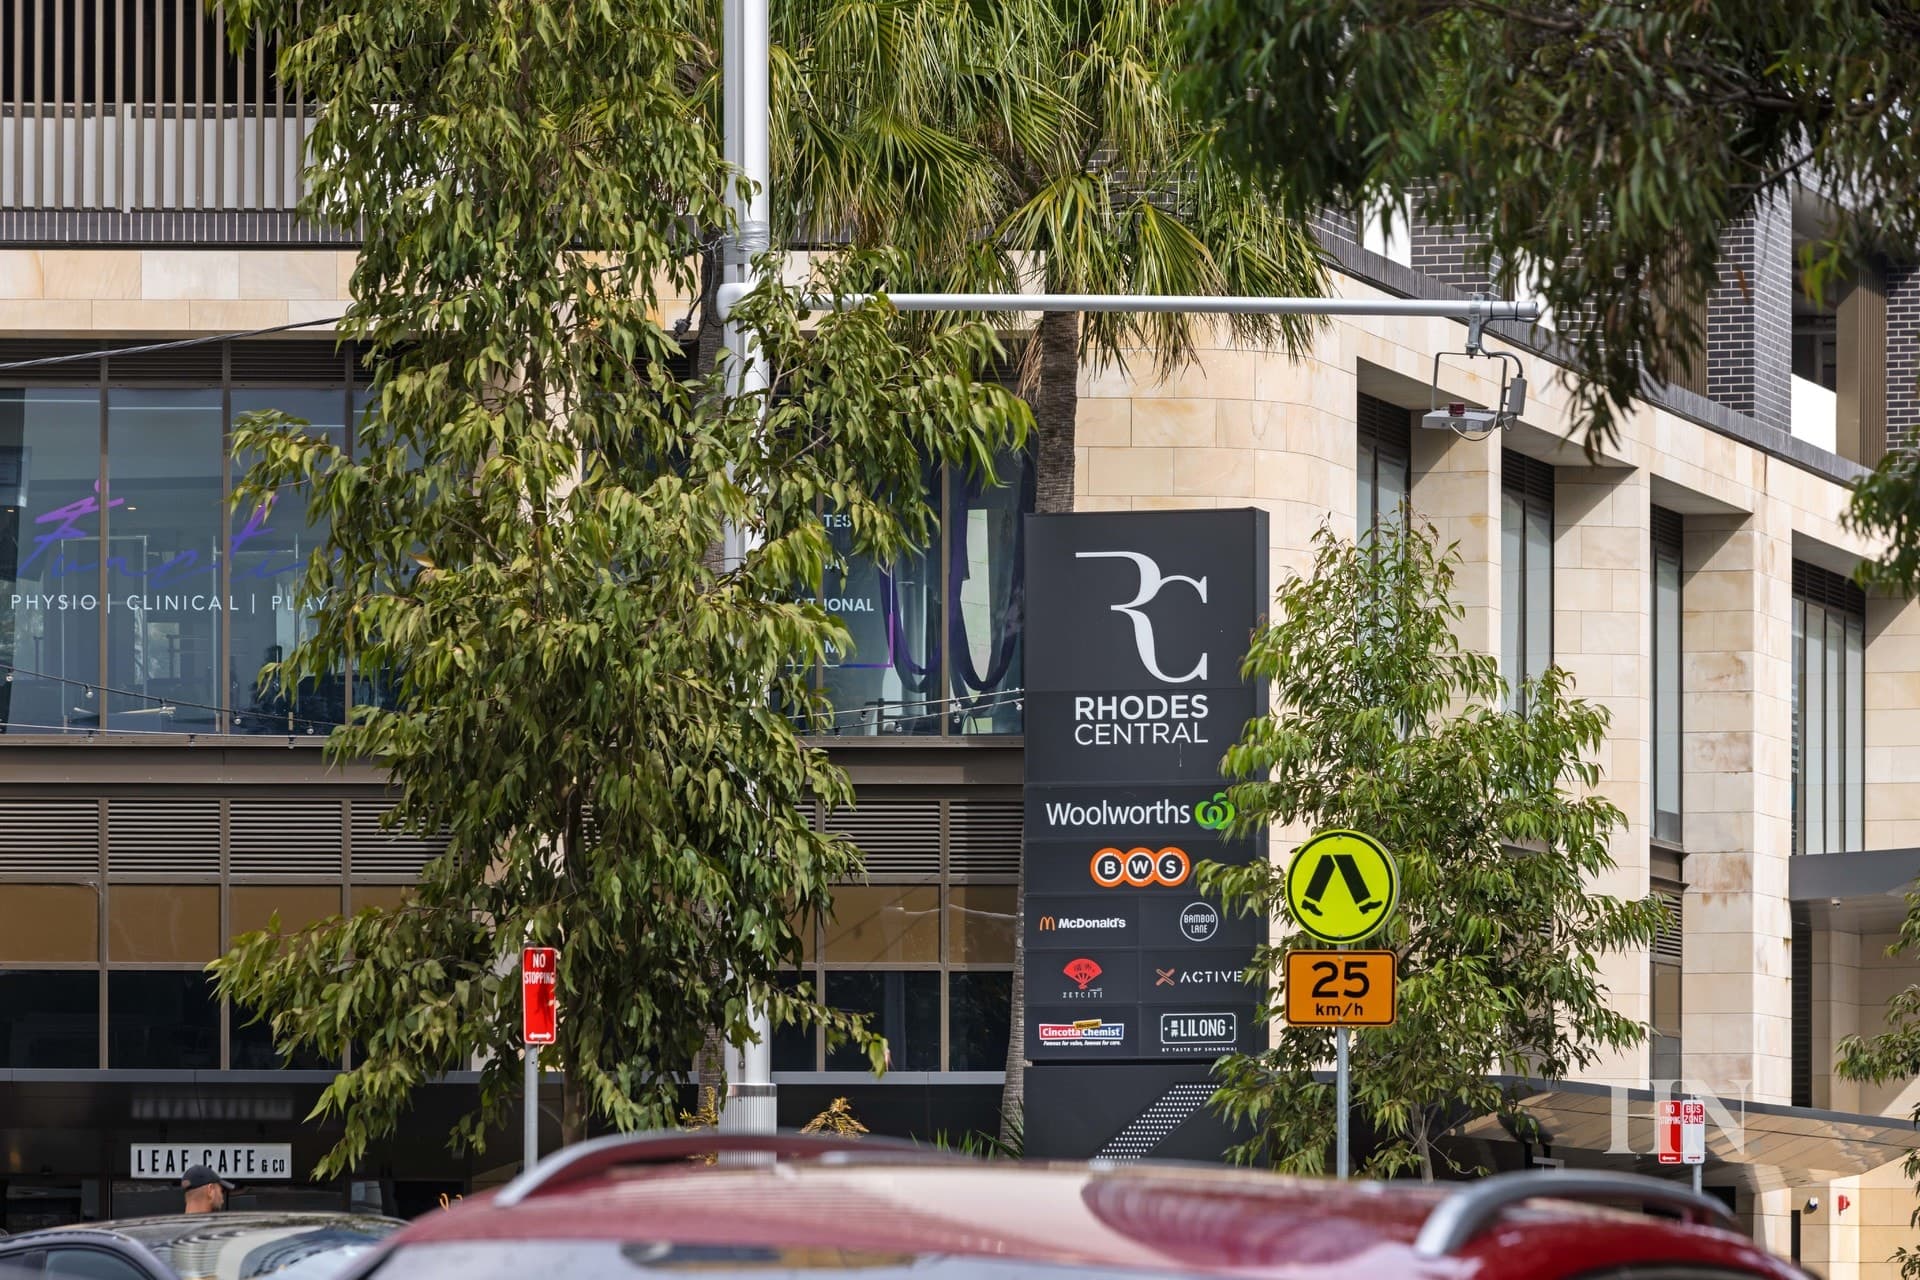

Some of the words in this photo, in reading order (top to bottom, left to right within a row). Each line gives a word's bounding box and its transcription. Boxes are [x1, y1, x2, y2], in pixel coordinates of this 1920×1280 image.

[11, 594, 98, 611] PHYSIO
[126, 594, 239, 611] CLINICAL
[1075, 694, 1208, 720] RHODES
[1074, 722, 1208, 745] CENTRAL
[1046, 798, 1190, 826] Woolworths
[1103, 860, 1177, 875] BWS
[1058, 917, 1126, 929] McDonald's
[1184, 914, 1215, 923] BAMBOO
[1191, 925, 1208, 933] LANE
[532, 953, 546, 968] NO
[524, 971, 555, 984] STOPPING
[1180, 971, 1243, 983] ACTIVE
[1312, 961, 1370, 998] 25
[1316, 1003, 1363, 1016] km/h
[1042, 1027, 1081, 1037] Cincotta
[1082, 1027, 1121, 1037] Chemist
[1180, 1019, 1226, 1037] LILONG
[1665, 1104, 1675, 1114] NO
[1686, 1105, 1701, 1113] BUS
[1684, 1115, 1703, 1124] ZONE
[137, 1150, 189, 1172] LEAF
[203, 1150, 255, 1172] CAFE
[272, 1159, 285, 1172] CO
